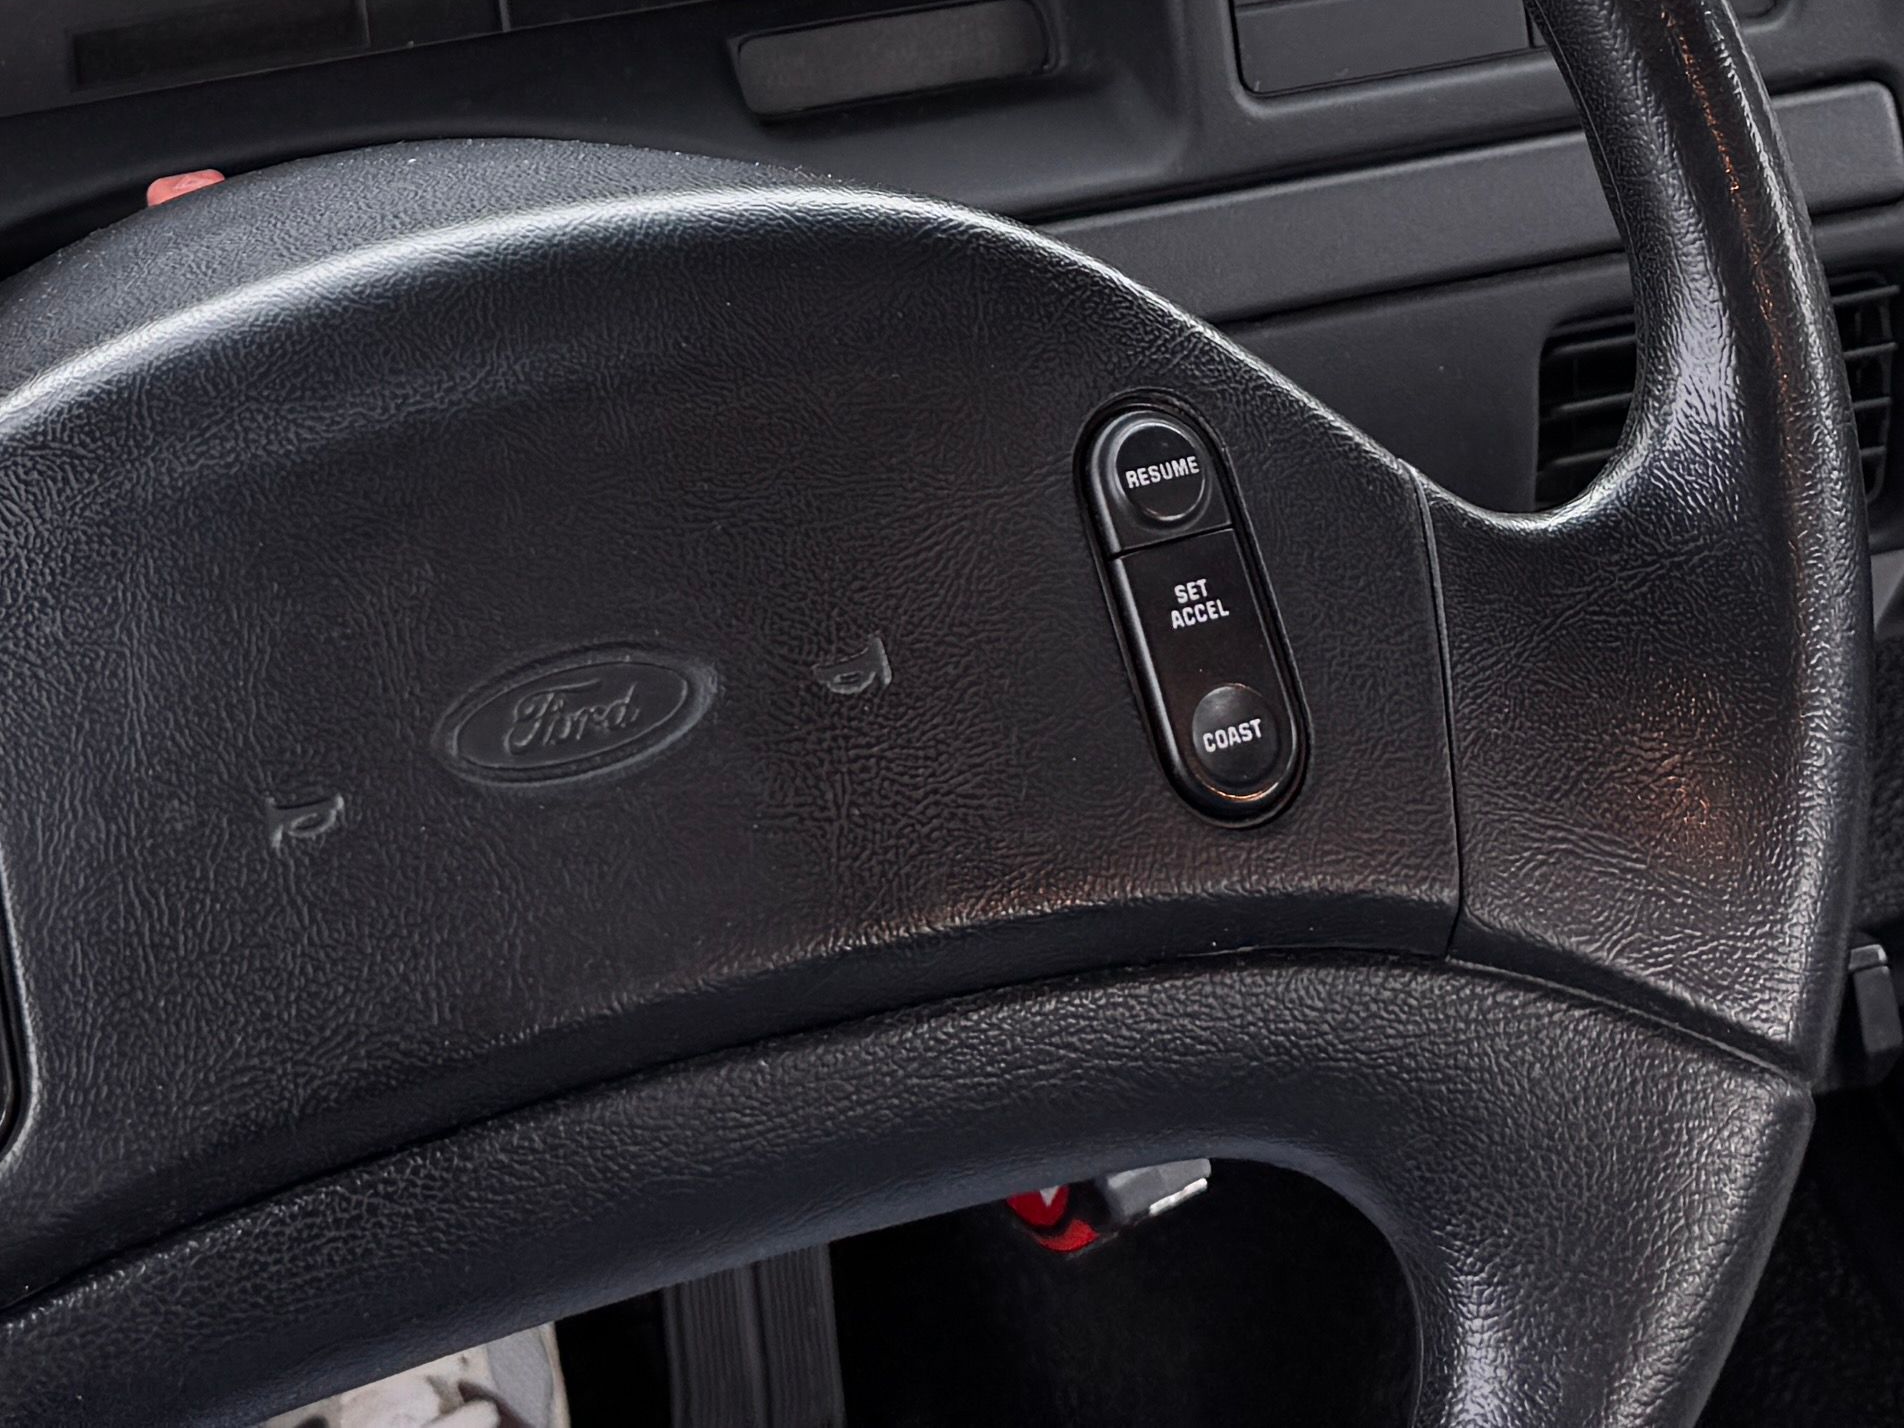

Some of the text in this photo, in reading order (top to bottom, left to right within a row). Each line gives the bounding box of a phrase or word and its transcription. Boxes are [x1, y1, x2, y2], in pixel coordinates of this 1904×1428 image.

[1125, 455, 1200, 489] RESUME
[1173, 578, 1208, 604] SET
[1170, 598, 1230, 630] ACCEL
[503, 679, 642, 757] Ford
[1202, 718, 1263, 753] COAST
